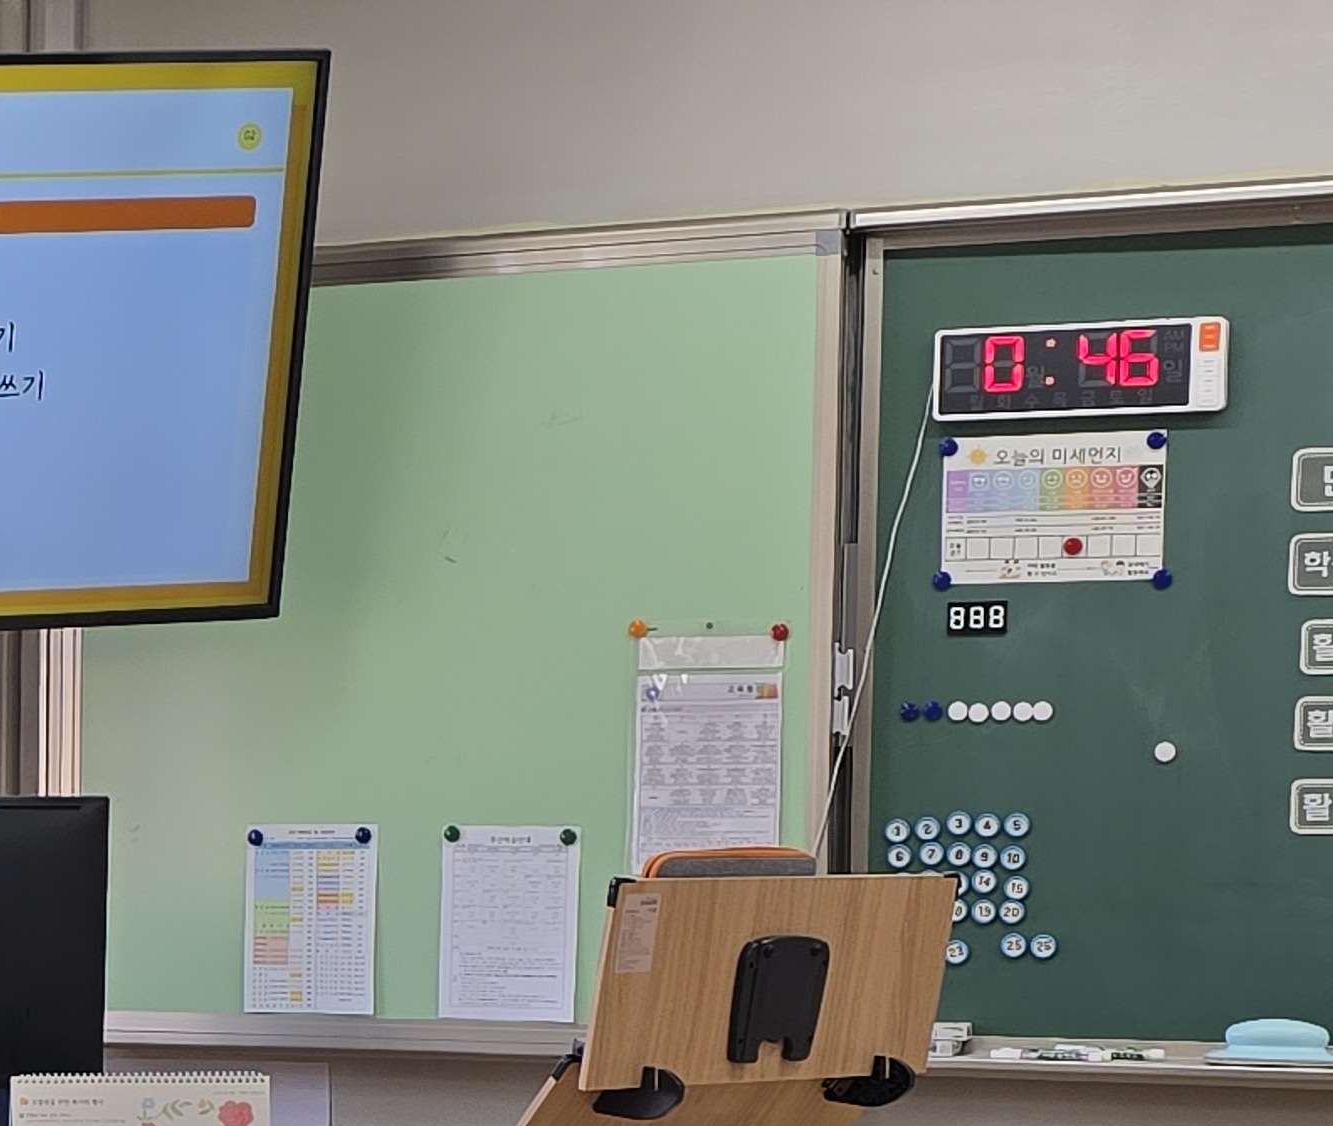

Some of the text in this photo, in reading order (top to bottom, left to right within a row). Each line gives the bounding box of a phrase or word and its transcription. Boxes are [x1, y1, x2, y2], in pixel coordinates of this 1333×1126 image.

[993, 449, 1044, 466] 오늘의
[1052, 447, 1121, 465] 미세먼지
[1304, 551, 1333, 578] 학
[954, 819, 963, 829] 3
[983, 820, 991, 830] 4
[1013, 820, 1021, 830] 5
[896, 851, 904, 861] 6
[927, 849, 935, 859] 7
[981, 852, 988, 861] 9
[1007, 853, 1020, 863] 10
[979, 876, 1023, 893] 14 15
[979, 906, 1019, 917] 19 20
[1007, 940, 1022, 951] 25
